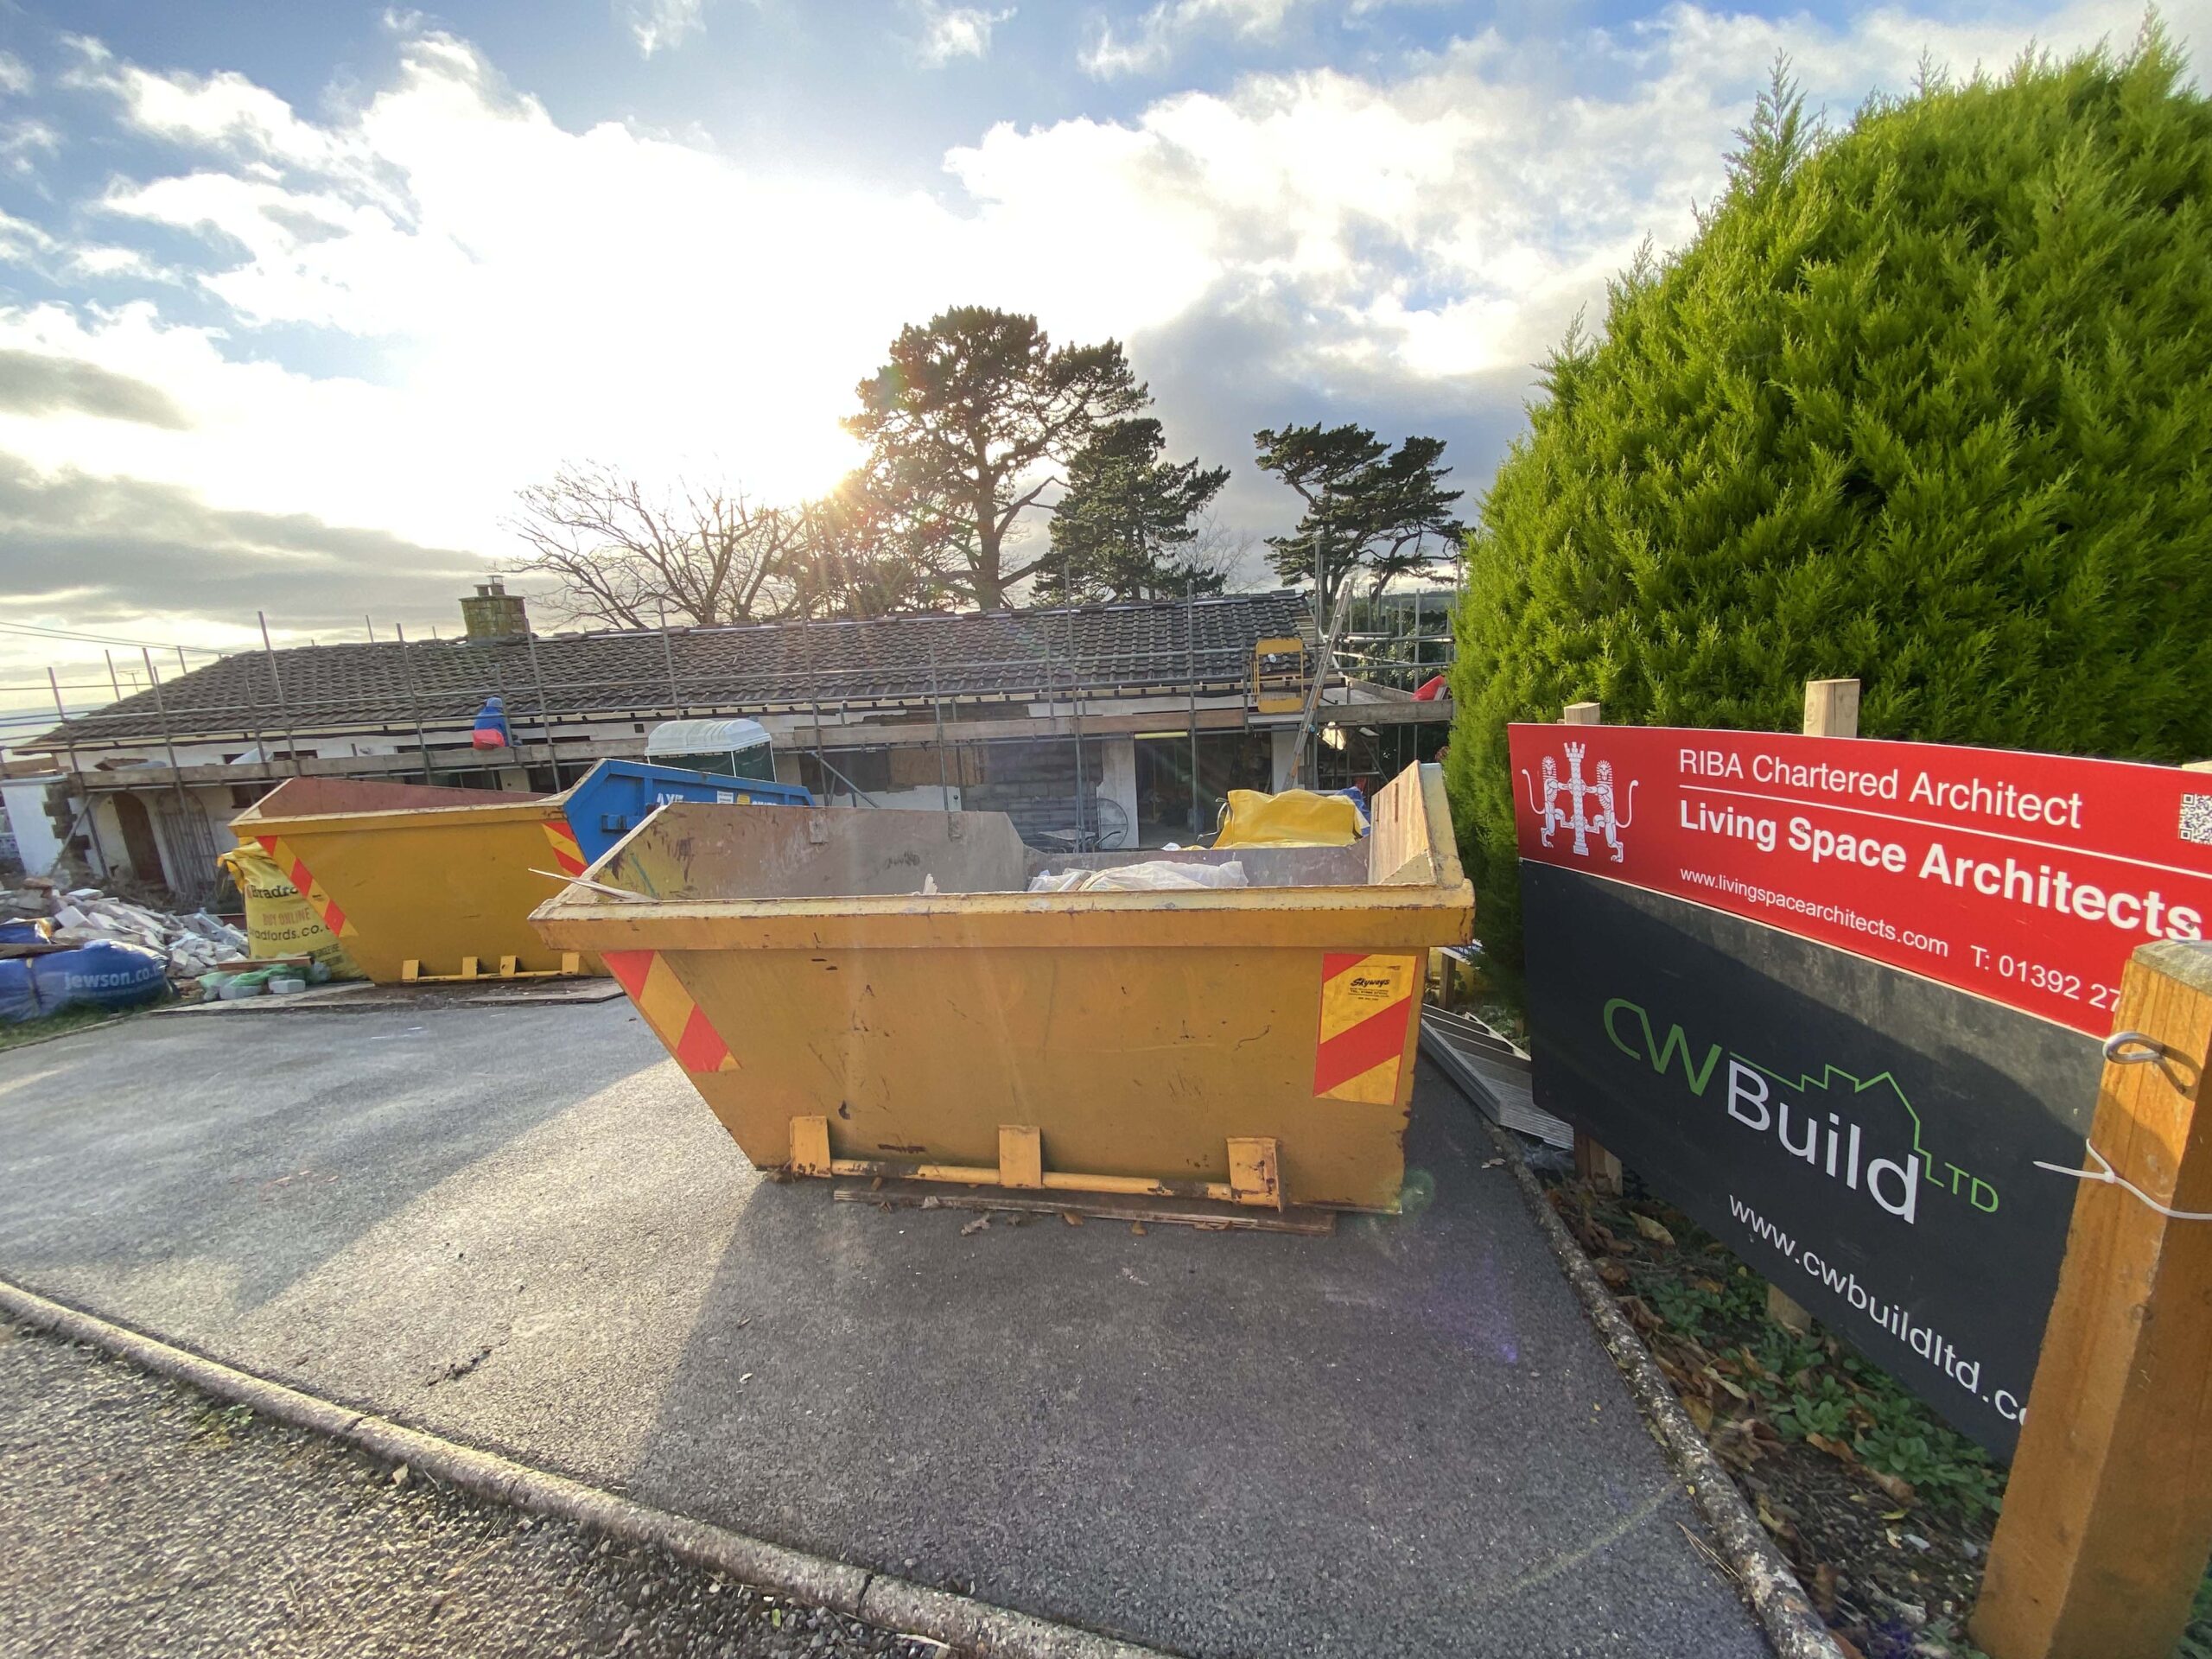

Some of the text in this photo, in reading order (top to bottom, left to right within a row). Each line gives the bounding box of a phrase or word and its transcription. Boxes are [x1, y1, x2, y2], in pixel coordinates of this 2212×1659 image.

[1680, 748, 2082, 829] RIBA Chartered Architect
[1681, 800, 2202, 941] Living Space Architects
[278, 907, 311, 926] ONLINE
[1680, 868, 1948, 957] www.livingspacearchitects.com
[1970, 944, 1990, 970] T:
[1999, 955, 2081, 1000] 01392
[1350, 977, 1390, 988] Skyways
